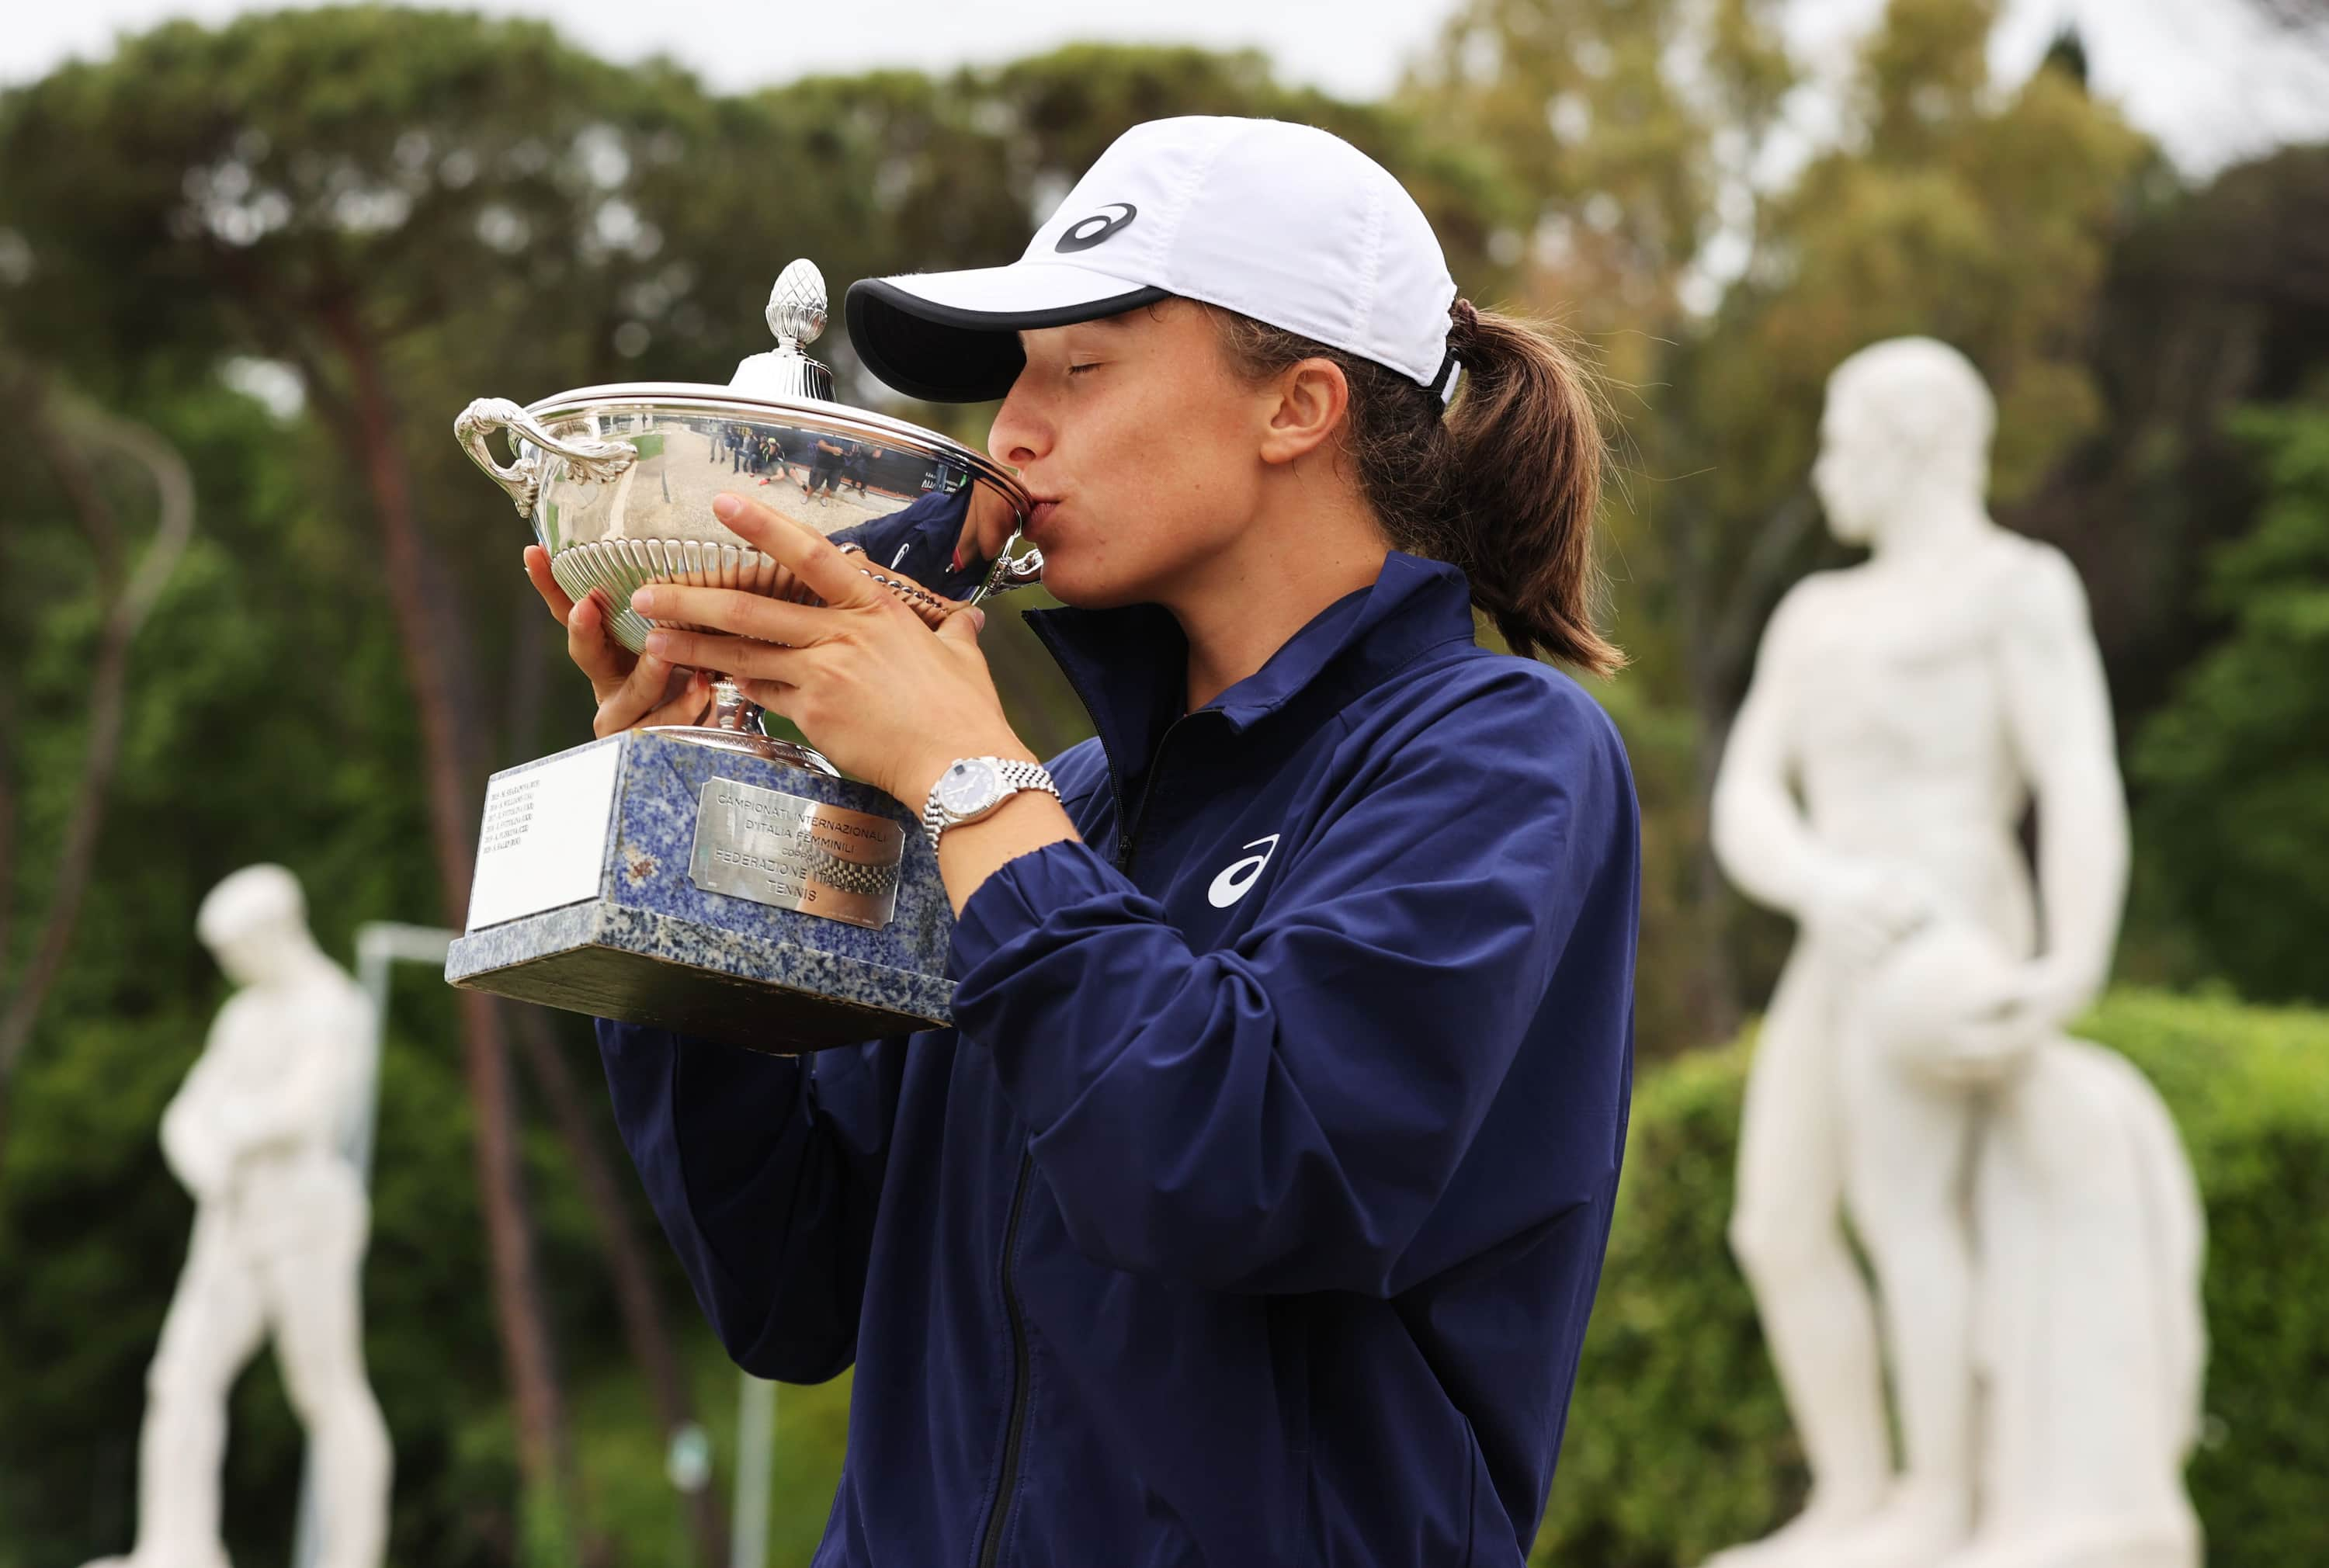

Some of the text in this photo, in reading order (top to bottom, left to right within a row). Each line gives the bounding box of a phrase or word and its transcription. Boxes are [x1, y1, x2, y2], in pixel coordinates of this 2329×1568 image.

[717, 794, 887, 843] CAMPIONATI INTERNAZIONALI
[745, 819, 855, 854] D'ITALIA FEMMINILI
[714, 847, 808, 880] FEDERAZIONE
[782, 847, 814, 862] COPPA
[765, 879, 817, 902] TENNIS
